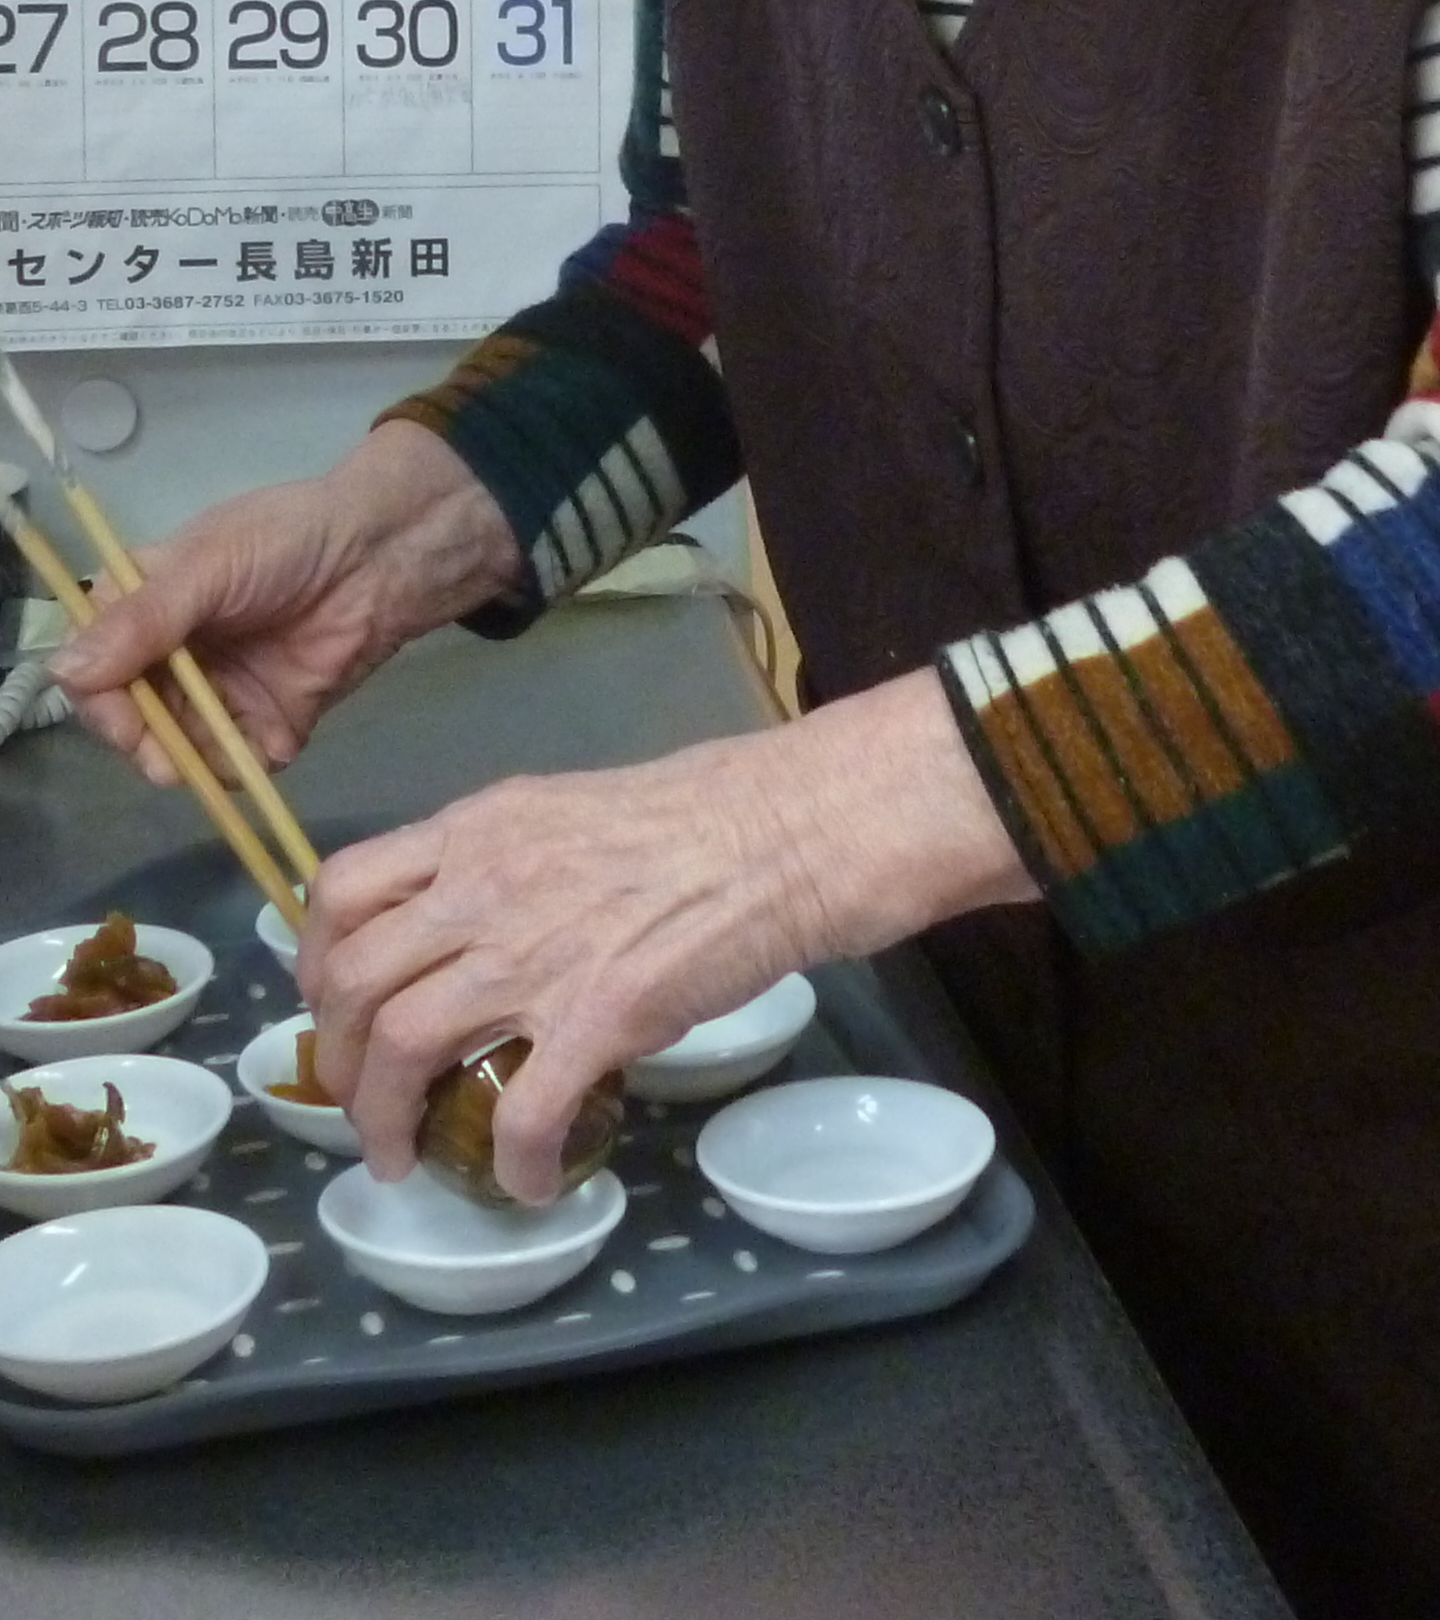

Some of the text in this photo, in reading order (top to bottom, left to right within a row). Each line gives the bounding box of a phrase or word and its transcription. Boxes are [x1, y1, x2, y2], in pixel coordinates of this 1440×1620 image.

[98, 2, 199, 72] 28
[229, 0, 328, 69] 29
[96, 294, 245, 313] TEL03-3687-2752
[253, 289, 405, 308] FAX03-3675-1520
